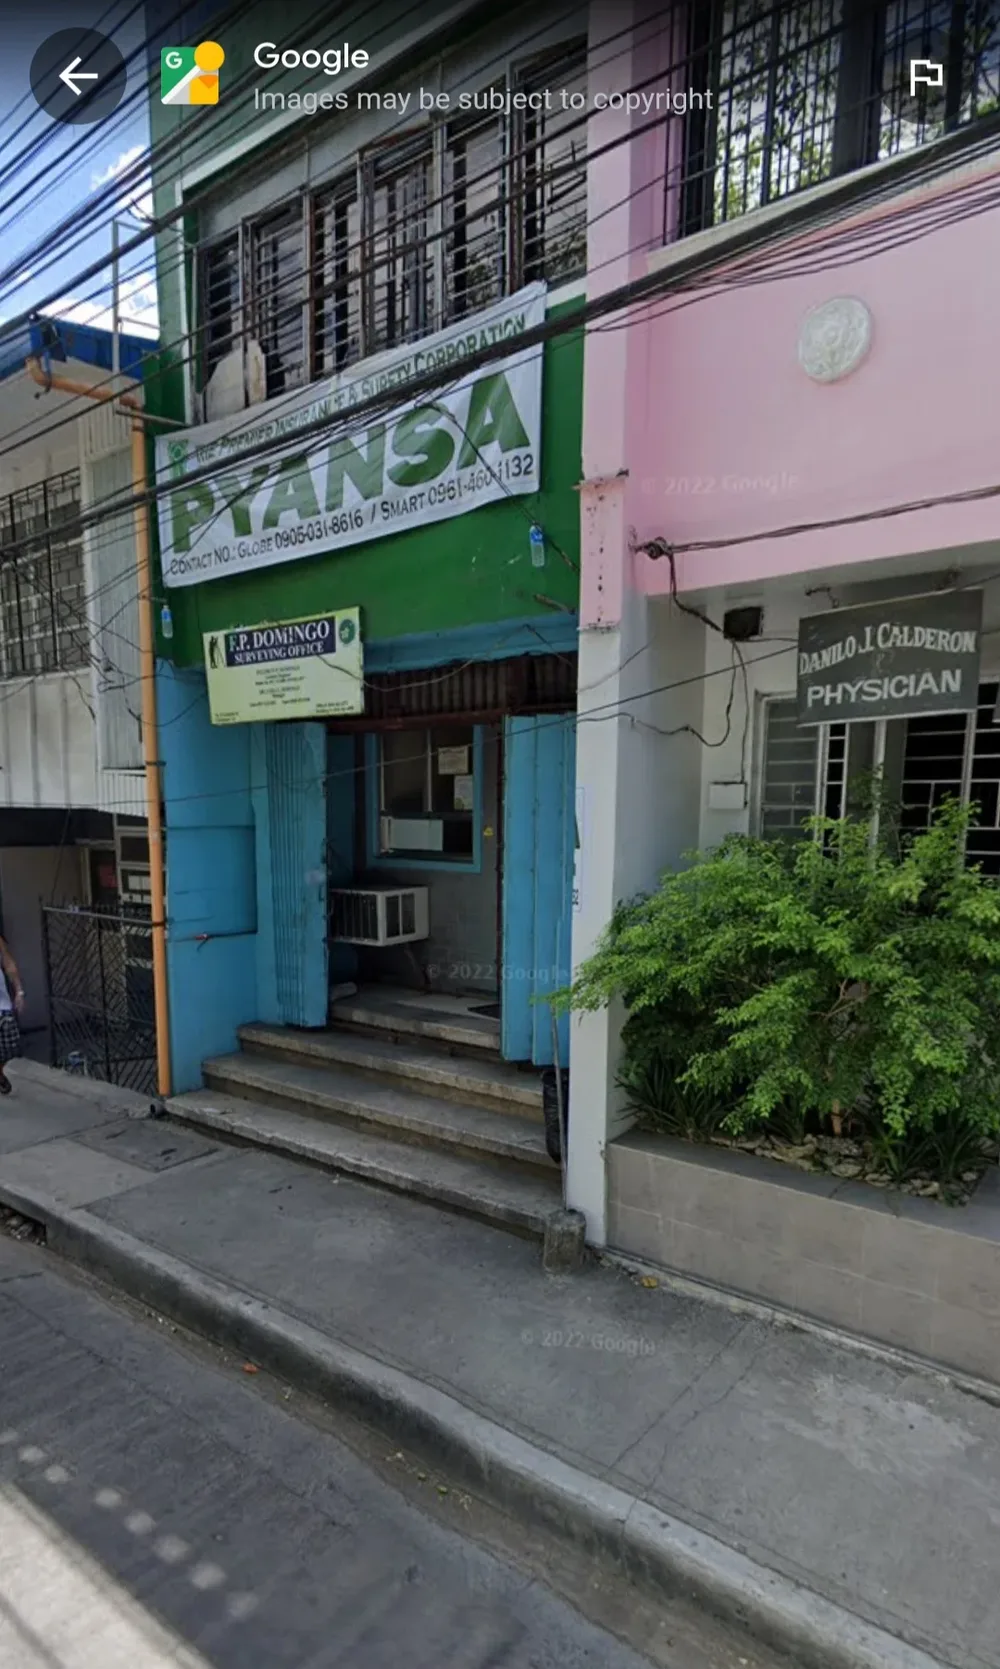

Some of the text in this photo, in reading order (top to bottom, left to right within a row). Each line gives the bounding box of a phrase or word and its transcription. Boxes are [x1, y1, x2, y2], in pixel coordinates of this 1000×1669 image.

[414, 313, 526, 376] CORPORATION
[171, 371, 531, 553] PYANSA
[170, 551, 212, 575] CONTACT
[238, 538, 273, 558] GLOBE
[275, 508, 363, 550] 0905-031-8616
[381, 491, 424, 521] SMART
[229, 620, 330, 651] F.P. DOMINGO
[234, 641, 324, 664] SURVEYING OFFICE
[800, 636, 856, 675] DANILO
[876, 621, 977, 653] CALDERON
[807, 668, 962, 708] PHYSICIAN
